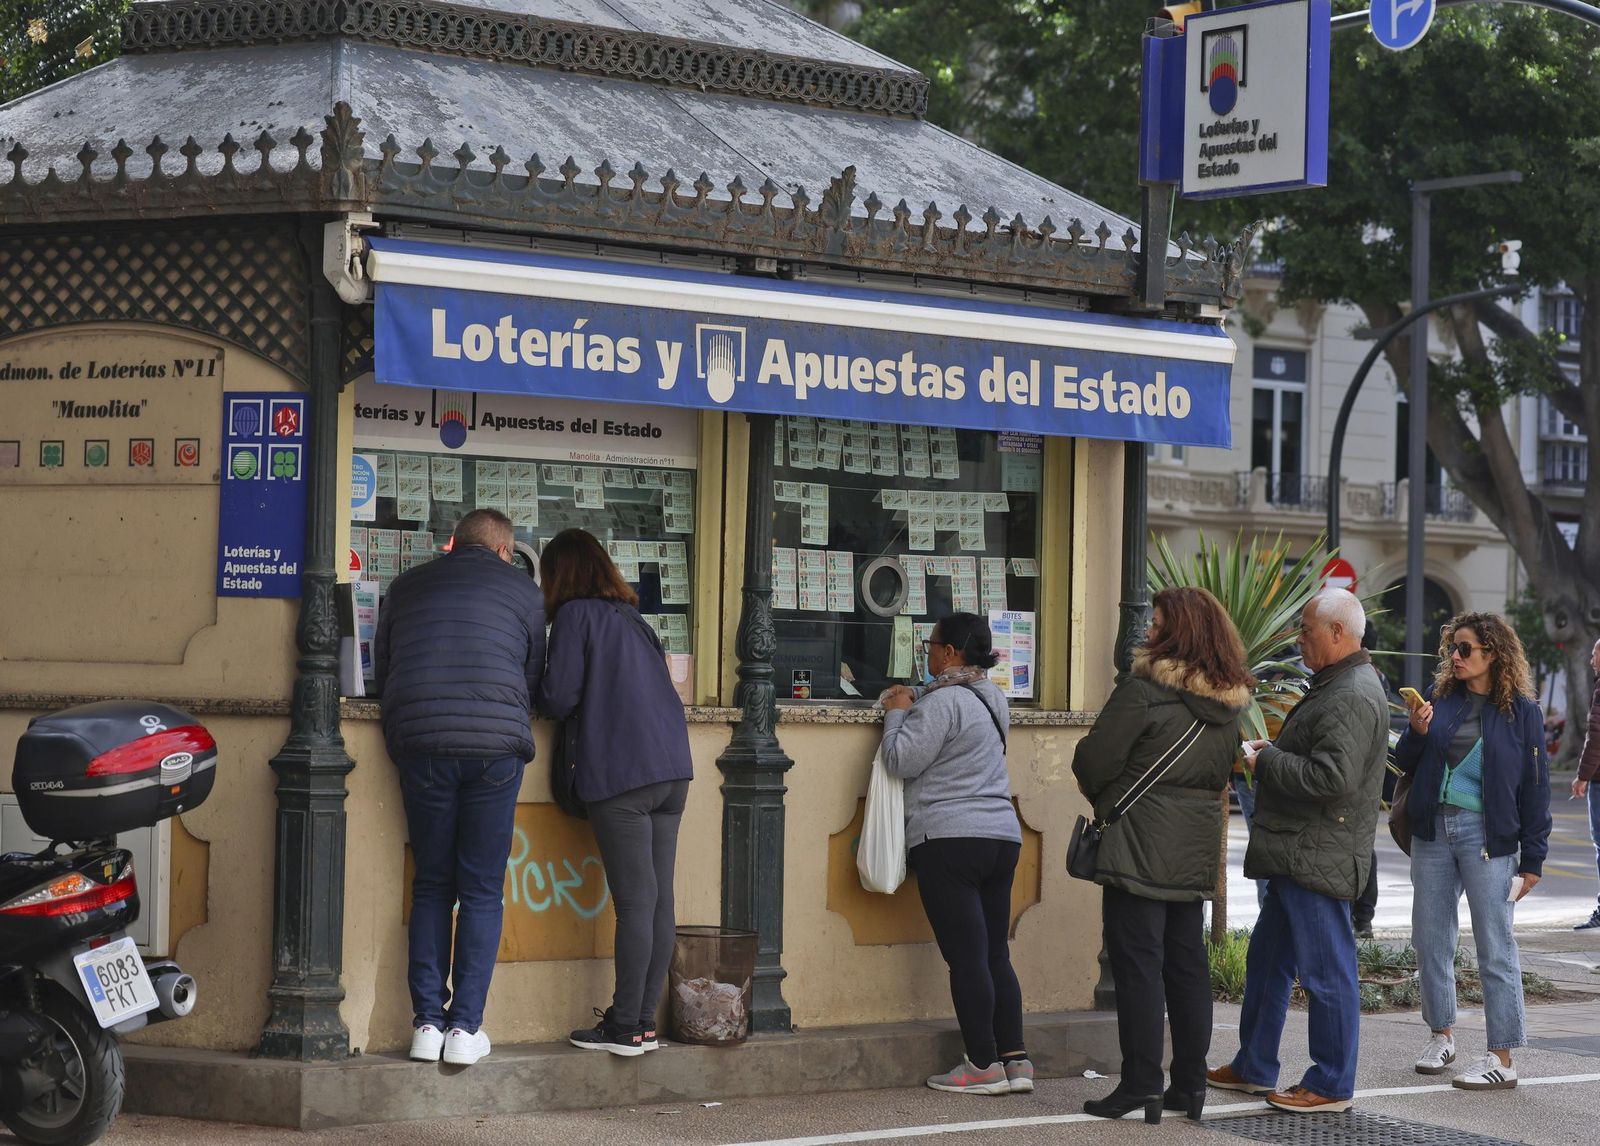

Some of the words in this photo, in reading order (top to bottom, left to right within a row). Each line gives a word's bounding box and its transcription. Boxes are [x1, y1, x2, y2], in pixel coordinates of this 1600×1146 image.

[1199, 117, 1249, 138] Loterías
[1252, 118, 1260, 136] y
[1199, 140, 1256, 160] Apuestas
[1258, 132, 1277, 151] del
[1198, 159, 1240, 178] Estado
[59, 360, 81, 379] de
[87, 357, 167, 379] Loterías
[431, 308, 641, 373] Loterías
[655, 340, 683, 390] y
[757, 338, 966, 401] Apuestas
[978, 356, 1041, 406] del
[1053, 365, 1192, 419] Estado
[52, 400, 148, 418] "Manolita"
[414, 405, 426, 426] y
[481, 412, 565, 435] Apuestas
[570, 418, 597, 434] del
[603, 421, 663, 439] Estado
[569, 451, 600, 463] Manolita
[605, 454, 658, 466] Administración
[660, 457, 675, 466] nº11
[224, 546, 271, 559] Loterías
[274, 549, 281, 561] y
[224, 561, 277, 576] Apuestas
[279, 561, 297, 576] del
[223, 577, 263, 591] Estado
[1002, 612, 1022, 620] BOTES
[97, 954, 139, 988] 6083
[106, 981, 138, 1012] FKT
